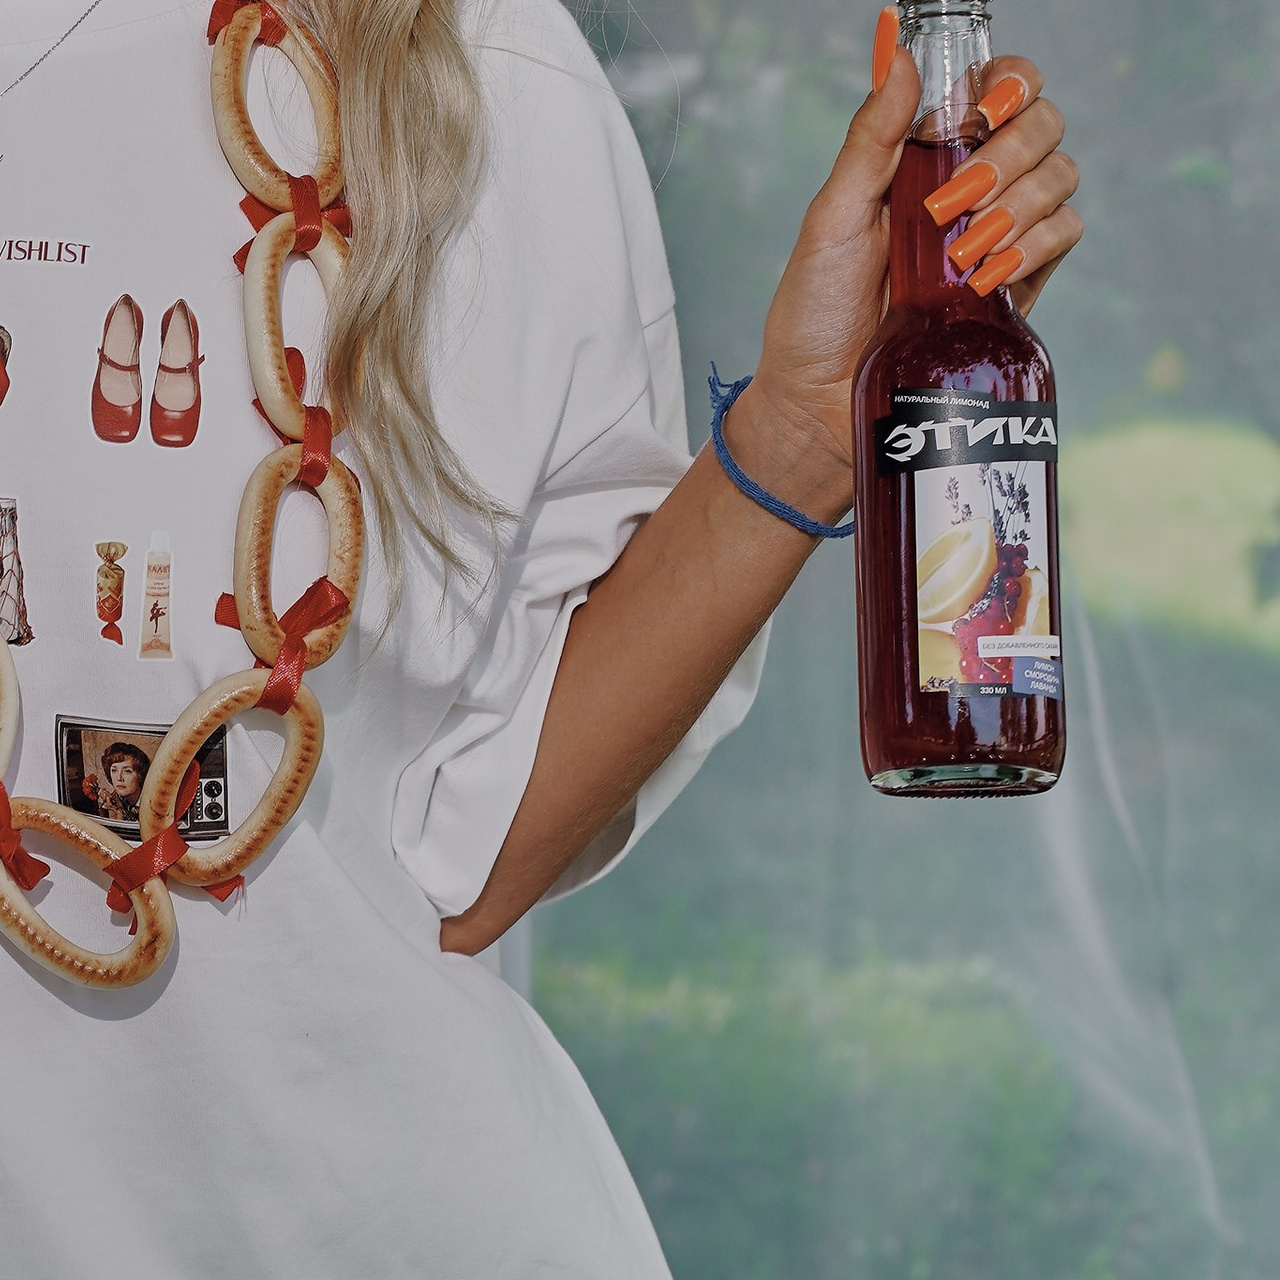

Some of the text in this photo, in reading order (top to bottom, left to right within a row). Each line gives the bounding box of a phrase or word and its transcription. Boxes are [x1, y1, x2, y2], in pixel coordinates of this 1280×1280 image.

[894, 395, 990, 410] НАТУРАЛЬНЫЙ ЛИМОНАД
[884, 417, 1057, 462] ЭТИКА
[1033, 661, 1055, 673] ЛИМОН
[979, 686, 1007, 695] 330 МЛ
